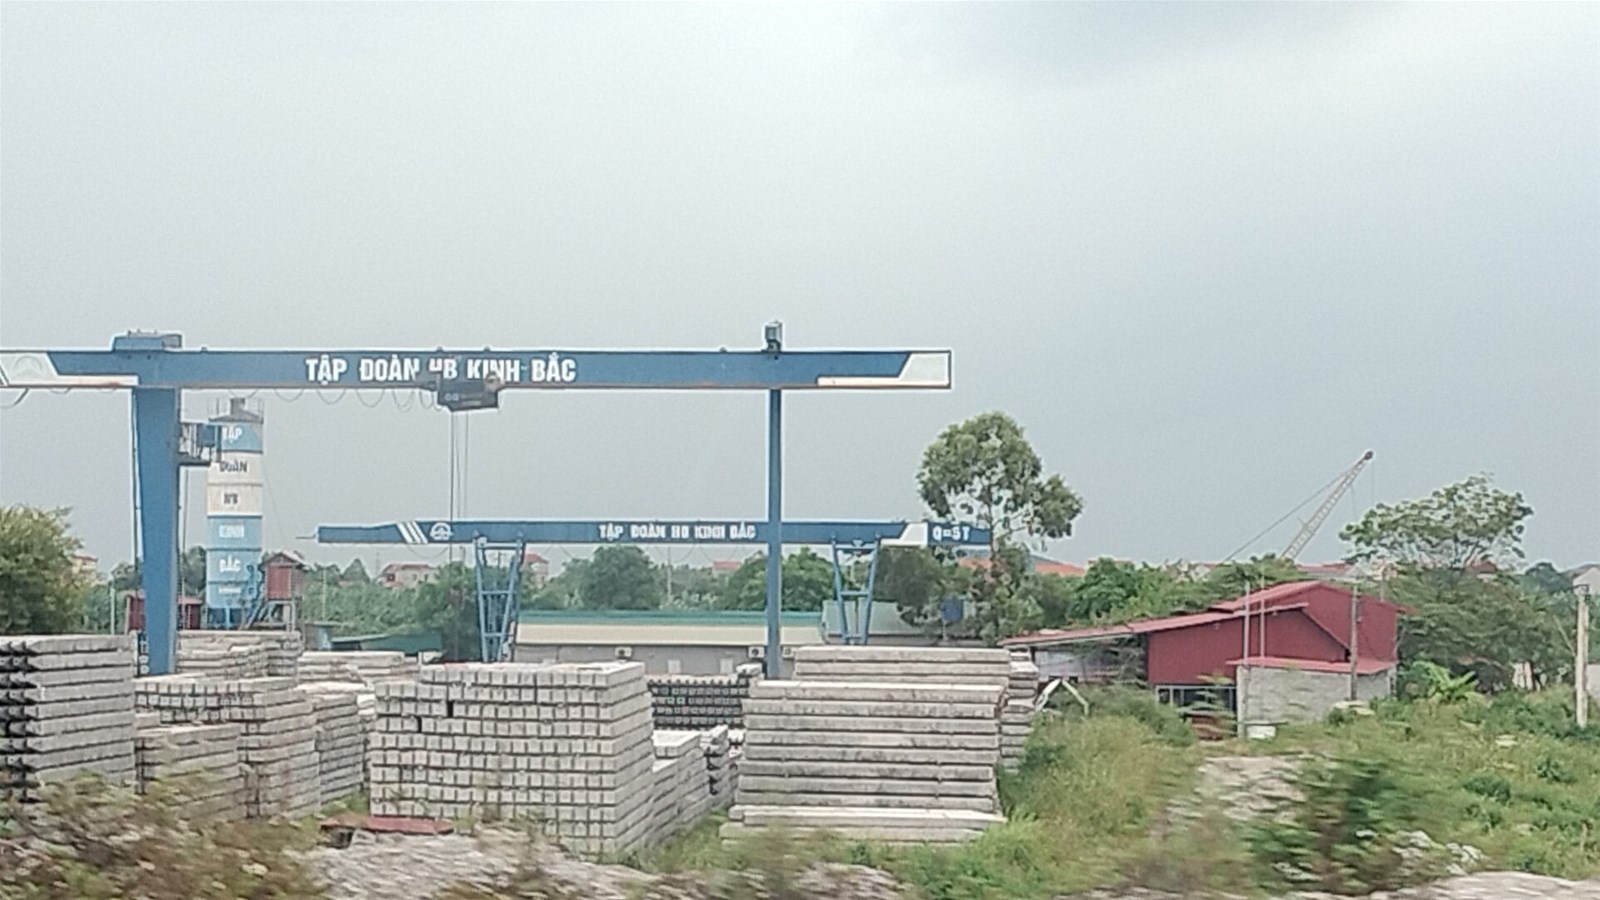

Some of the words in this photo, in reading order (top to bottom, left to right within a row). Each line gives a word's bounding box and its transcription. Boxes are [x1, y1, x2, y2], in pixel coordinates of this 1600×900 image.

[306, 354, 347, 385] TẬP
[359, 354, 419, 381] ĐOÀN
[466, 359, 520, 382] KINH
[531, 352, 577, 382] BẮC
